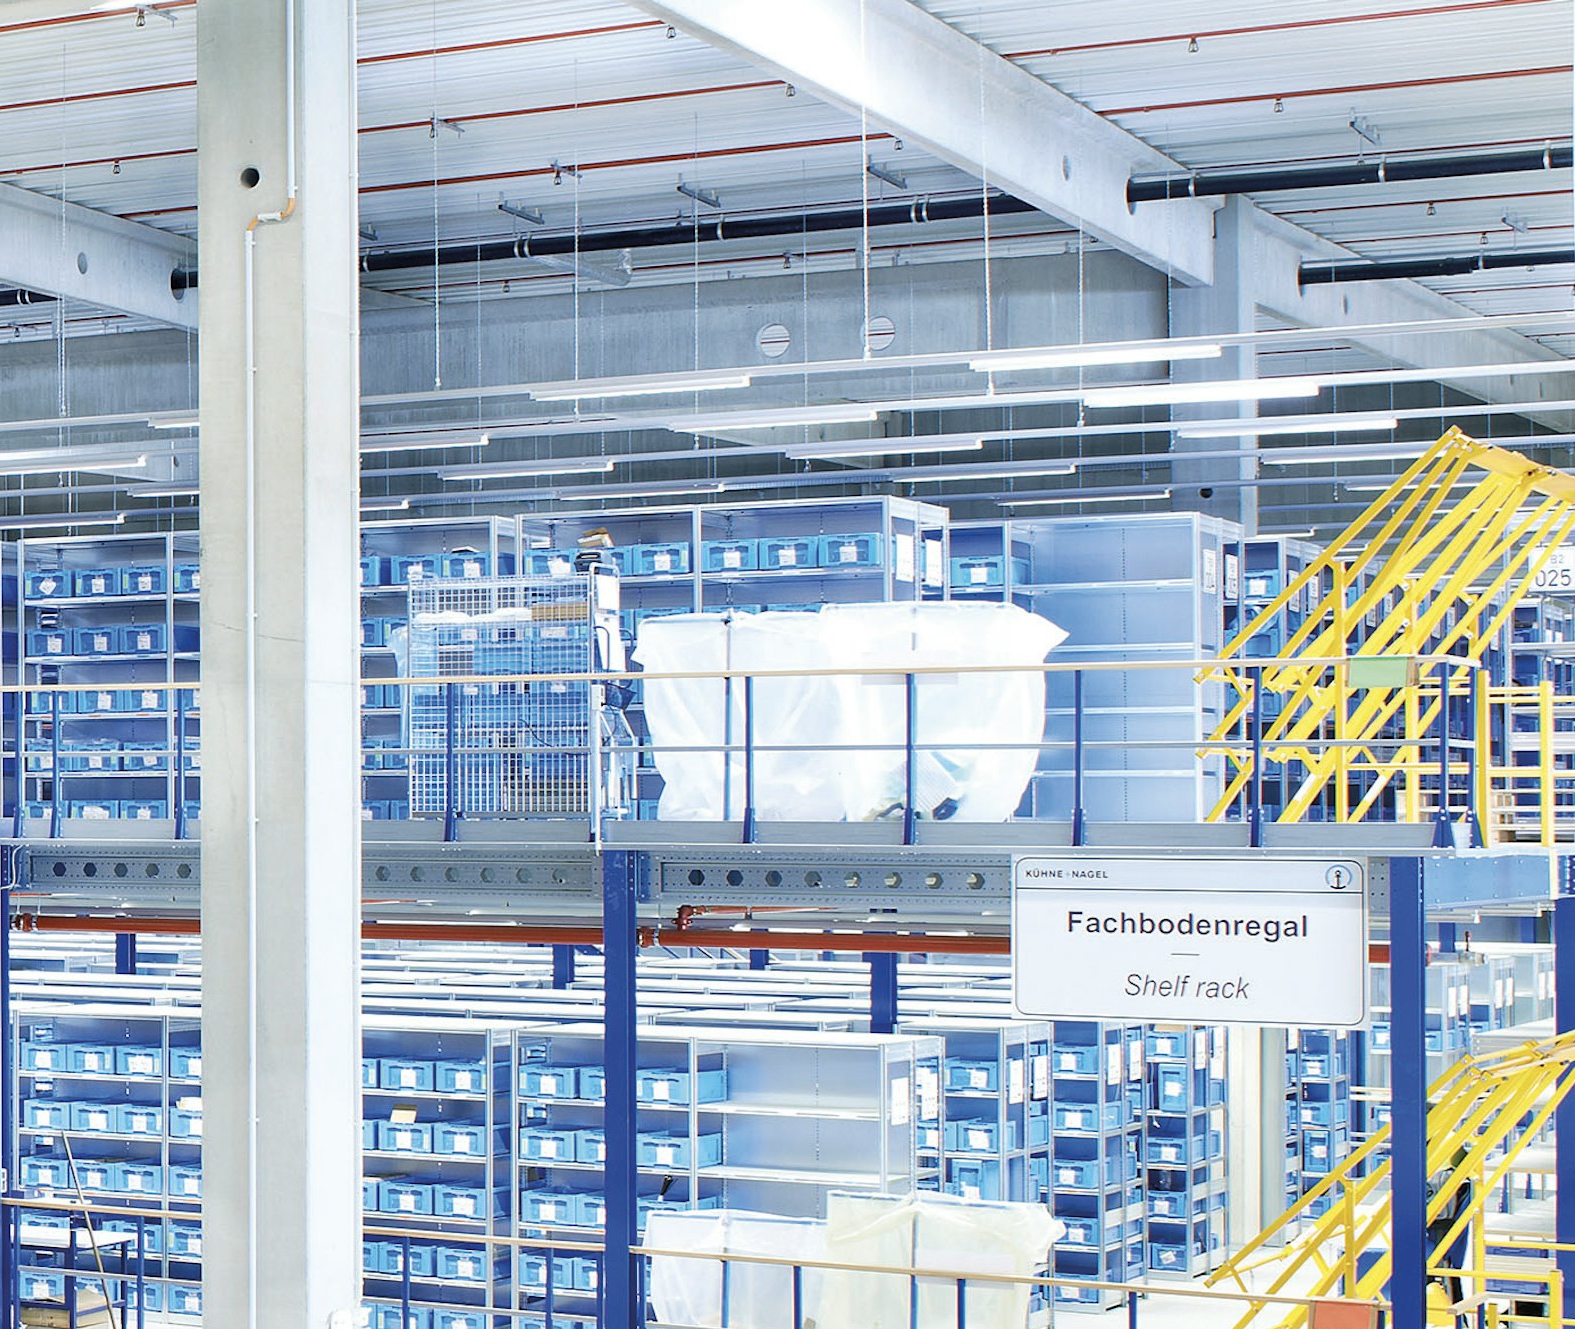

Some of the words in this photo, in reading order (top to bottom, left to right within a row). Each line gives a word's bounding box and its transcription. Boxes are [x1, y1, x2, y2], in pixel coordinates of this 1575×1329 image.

[1535, 569, 1571, 587] 025
[1067, 910, 1309, 943] Fachbodenregal
[1124, 973, 1189, 997] Shelf
[1195, 976, 1250, 1000] rack
